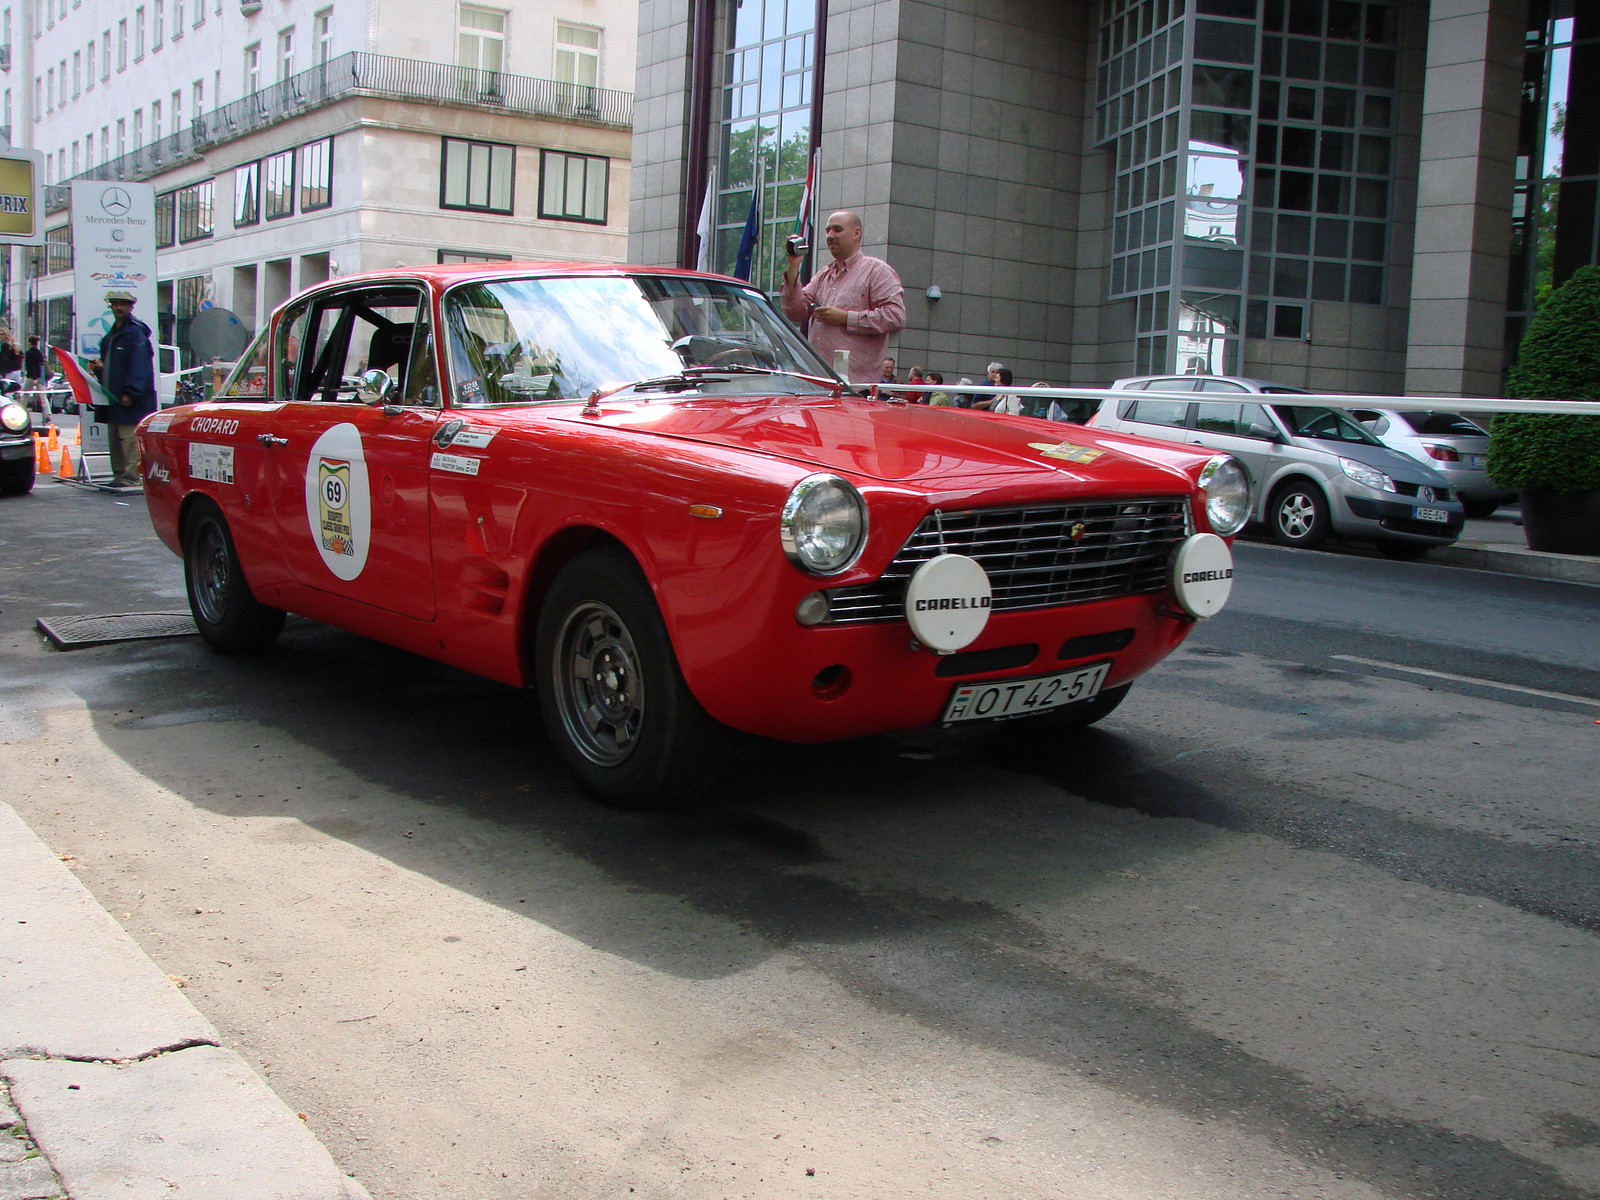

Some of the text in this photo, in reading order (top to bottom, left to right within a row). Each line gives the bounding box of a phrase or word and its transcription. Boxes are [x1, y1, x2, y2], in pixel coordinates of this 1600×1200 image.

[85, 215, 148, 226] Mercedes-Benz
[94, 246, 125, 254] Kempinski
[462, 380, 479, 391] 128
[90, 425, 100, 437] n
[190, 416, 240, 435] CHOPARD
[326, 480, 342, 503] 69
[1183, 568, 1233, 584] CARELLO
[915, 596, 991, 612] CARELLO
[949, 704, 963, 719] H
[1023, 668, 1103, 708] 42-51
